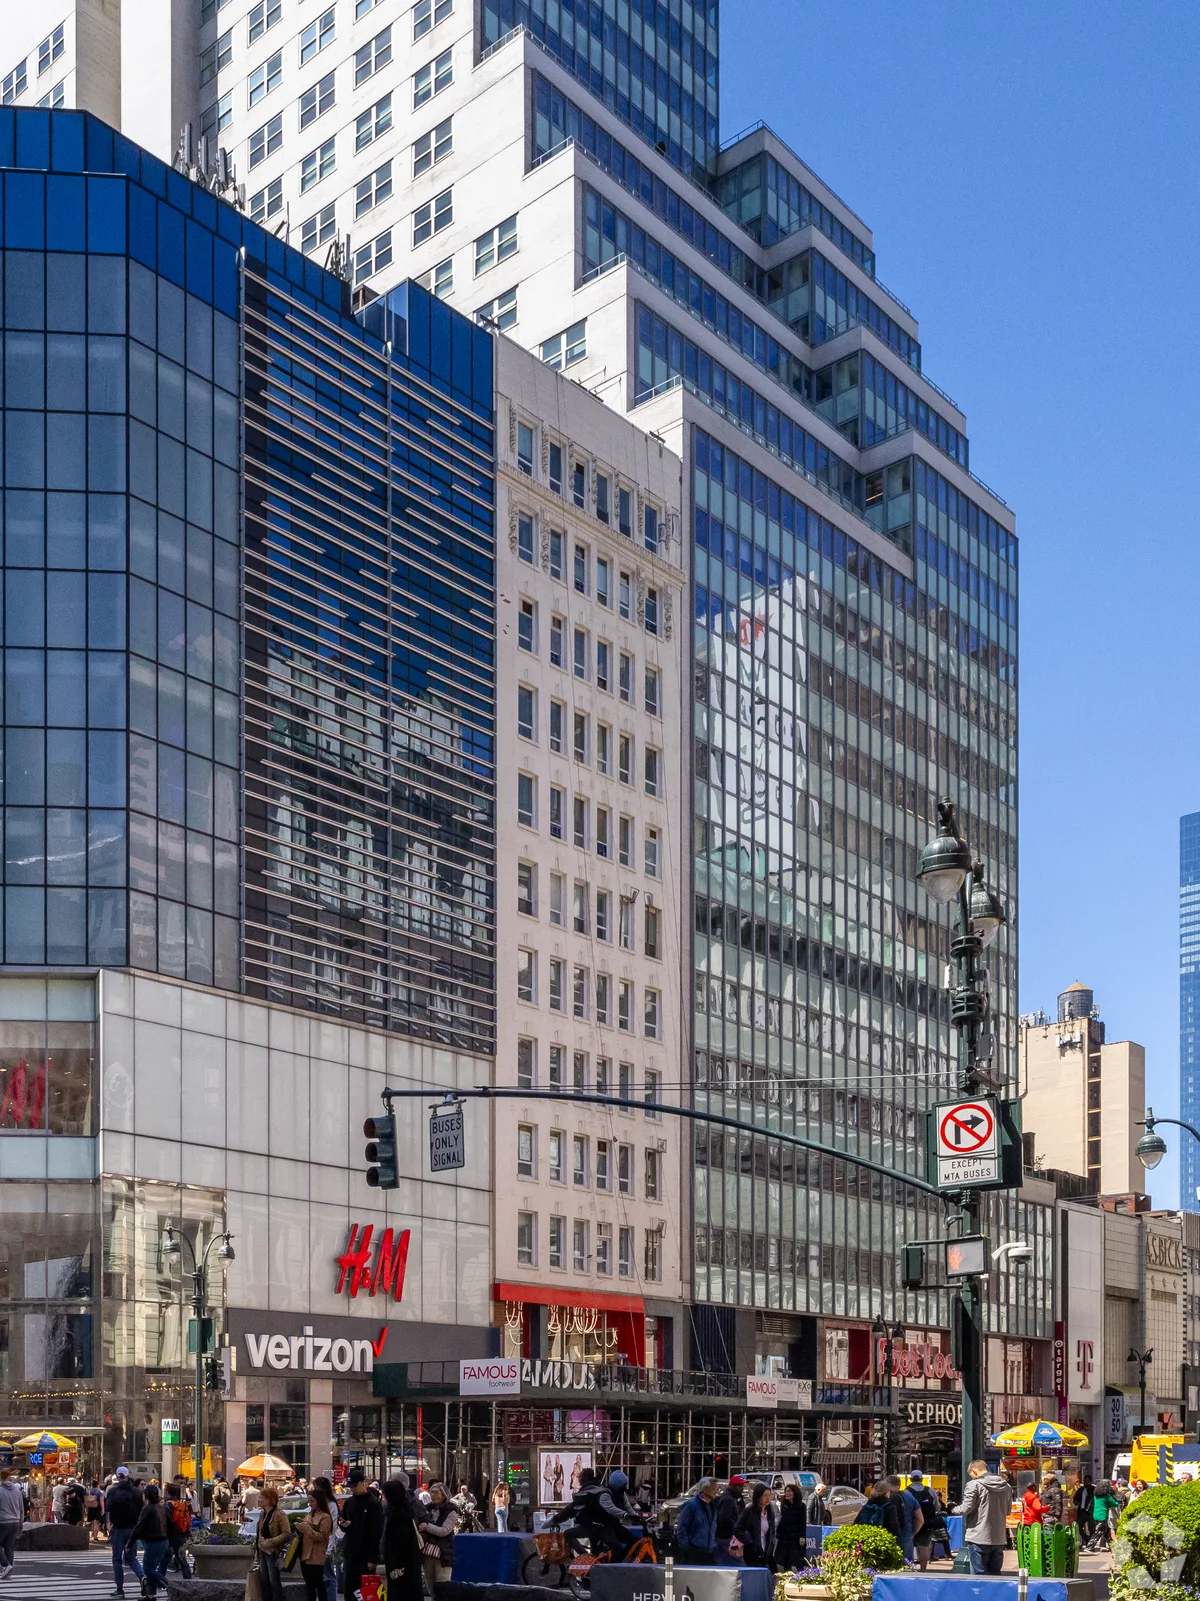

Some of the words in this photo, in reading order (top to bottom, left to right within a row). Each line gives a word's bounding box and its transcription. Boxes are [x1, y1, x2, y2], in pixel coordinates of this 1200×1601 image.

[432, 1117, 461, 1134] BUSES
[434, 1135, 459, 1150] ONLY
[433, 1151, 461, 1167] SIGNAL
[951, 1159, 982, 1169] EXCEPT
[944, 1173, 960, 1181] MTA
[963, 1168, 991, 1179] BUSES
[334, 1223, 411, 1302] H&M
[245, 1326, 374, 1372] verizon
[923, 1342, 963, 1379] Loc
[1077, 1339, 1094, 1389] T
[463, 1365, 517, 1380] FAMOUS
[522, 1358, 596, 1391] AMOUS
[1055, 1348, 1063, 1391] target
[488, 1380, 516, 1388] footwear
[748, 1381, 777, 1395] FAMOUS
[1111, 1398, 1121, 1413] 30
[907, 1402, 963, 1425] SEPHOR
[1111, 1418, 1121, 1432] 50
[633, 1592, 692, 1601] HERLD
